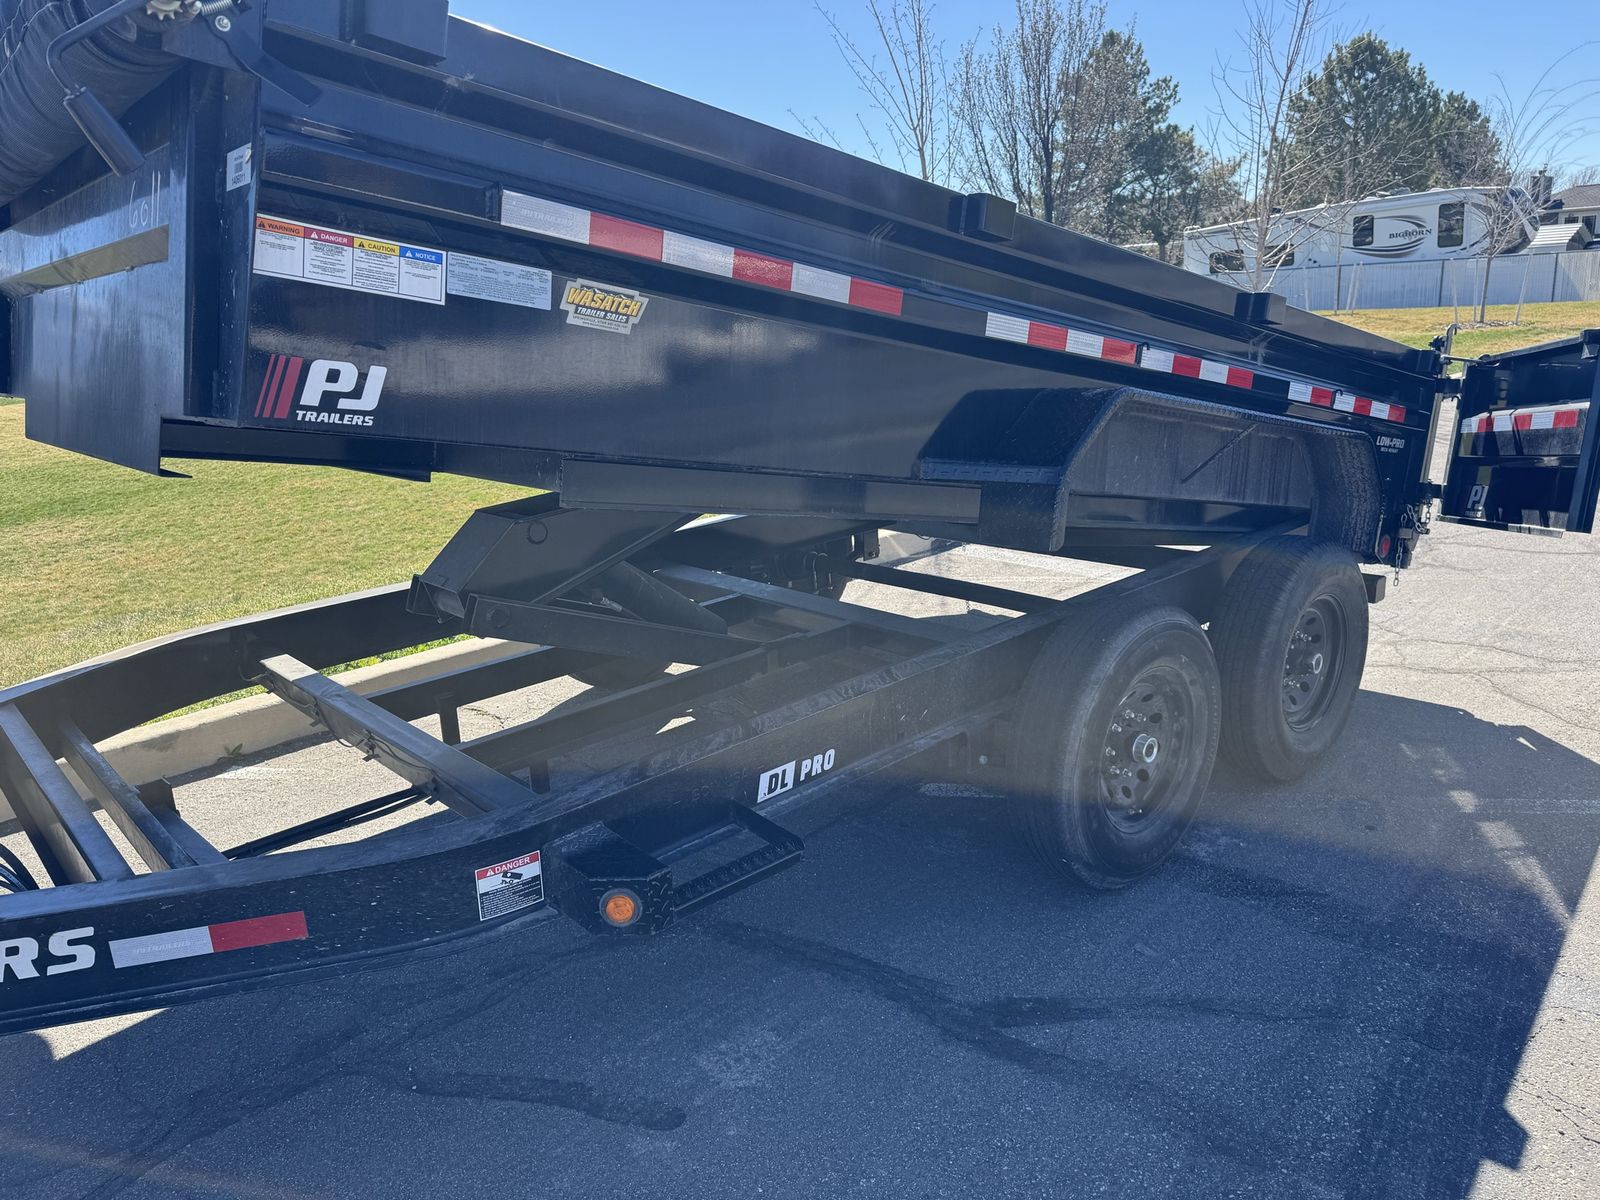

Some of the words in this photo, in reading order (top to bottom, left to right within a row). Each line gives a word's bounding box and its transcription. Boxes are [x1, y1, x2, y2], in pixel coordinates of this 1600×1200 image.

[267, 223, 300, 234] WARNING
[1388, 228, 1432, 239] BIGHORN
[320, 233, 348, 244] DANGER
[367, 243, 395, 253] CAUTION
[415, 252, 436, 261] NOTICE
[567, 287, 642, 316] WASATCH
[577, 307, 605, 319] TRAILER
[605, 312, 627, 322] SALES
[300, 359, 388, 412] PJ
[296, 410, 374, 426] TRAILERS
[1467, 484, 1489, 510] PJ
[800, 748, 836, 782] PRO
[495, 857, 530, 874] DANGER
